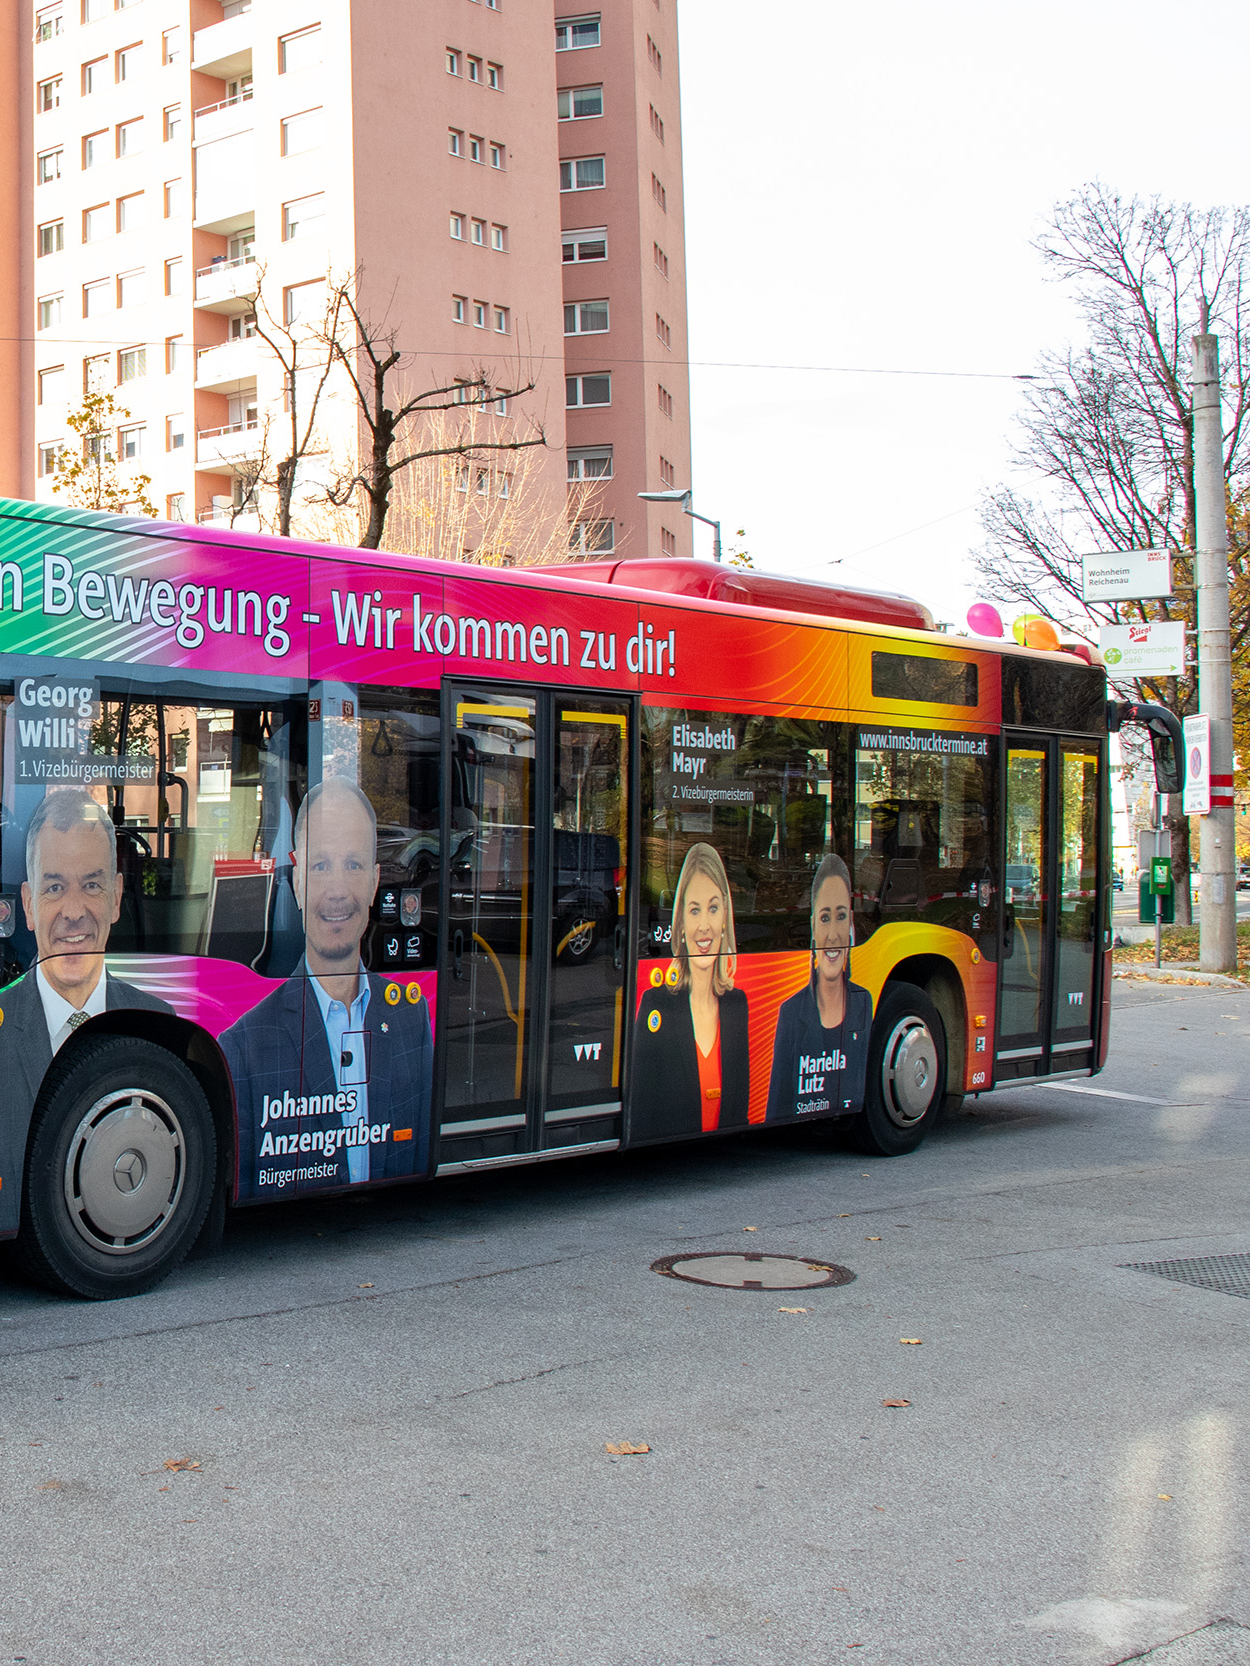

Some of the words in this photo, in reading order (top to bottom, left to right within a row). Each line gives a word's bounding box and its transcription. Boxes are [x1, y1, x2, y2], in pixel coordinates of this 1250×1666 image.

[1088, 568, 1130, 577] Wohnheim
[1088, 578, 1129, 586] Reichenau
[42, 551, 291, 658] Bewegung
[302, 612, 321, 625] -
[331, 588, 402, 651] Wir
[413, 592, 570, 667] kommen
[580, 629, 617, 670] zu
[626, 620, 676, 678] dir!
[1129, 626, 1152, 639] Stiegl
[1123, 645, 1178, 656] promenaden
[1123, 656, 1142, 664] café
[19, 678, 93, 717] Georg
[19, 717, 75, 748] Willi
[672, 724, 736, 750] Elisabeth
[860, 729, 987, 756] www.innsbrucktermine.at
[672, 752, 707, 780] Mayr
[799, 1049, 847, 1075] Mariella
[798, 1073, 825, 1095] Lutz
[972, 1071, 986, 1085] 660
[260, 1090, 358, 1128] Johannes
[259, 1117, 391, 1157] Anzengruber
[258, 1162, 339, 1188] Bürgermeister
